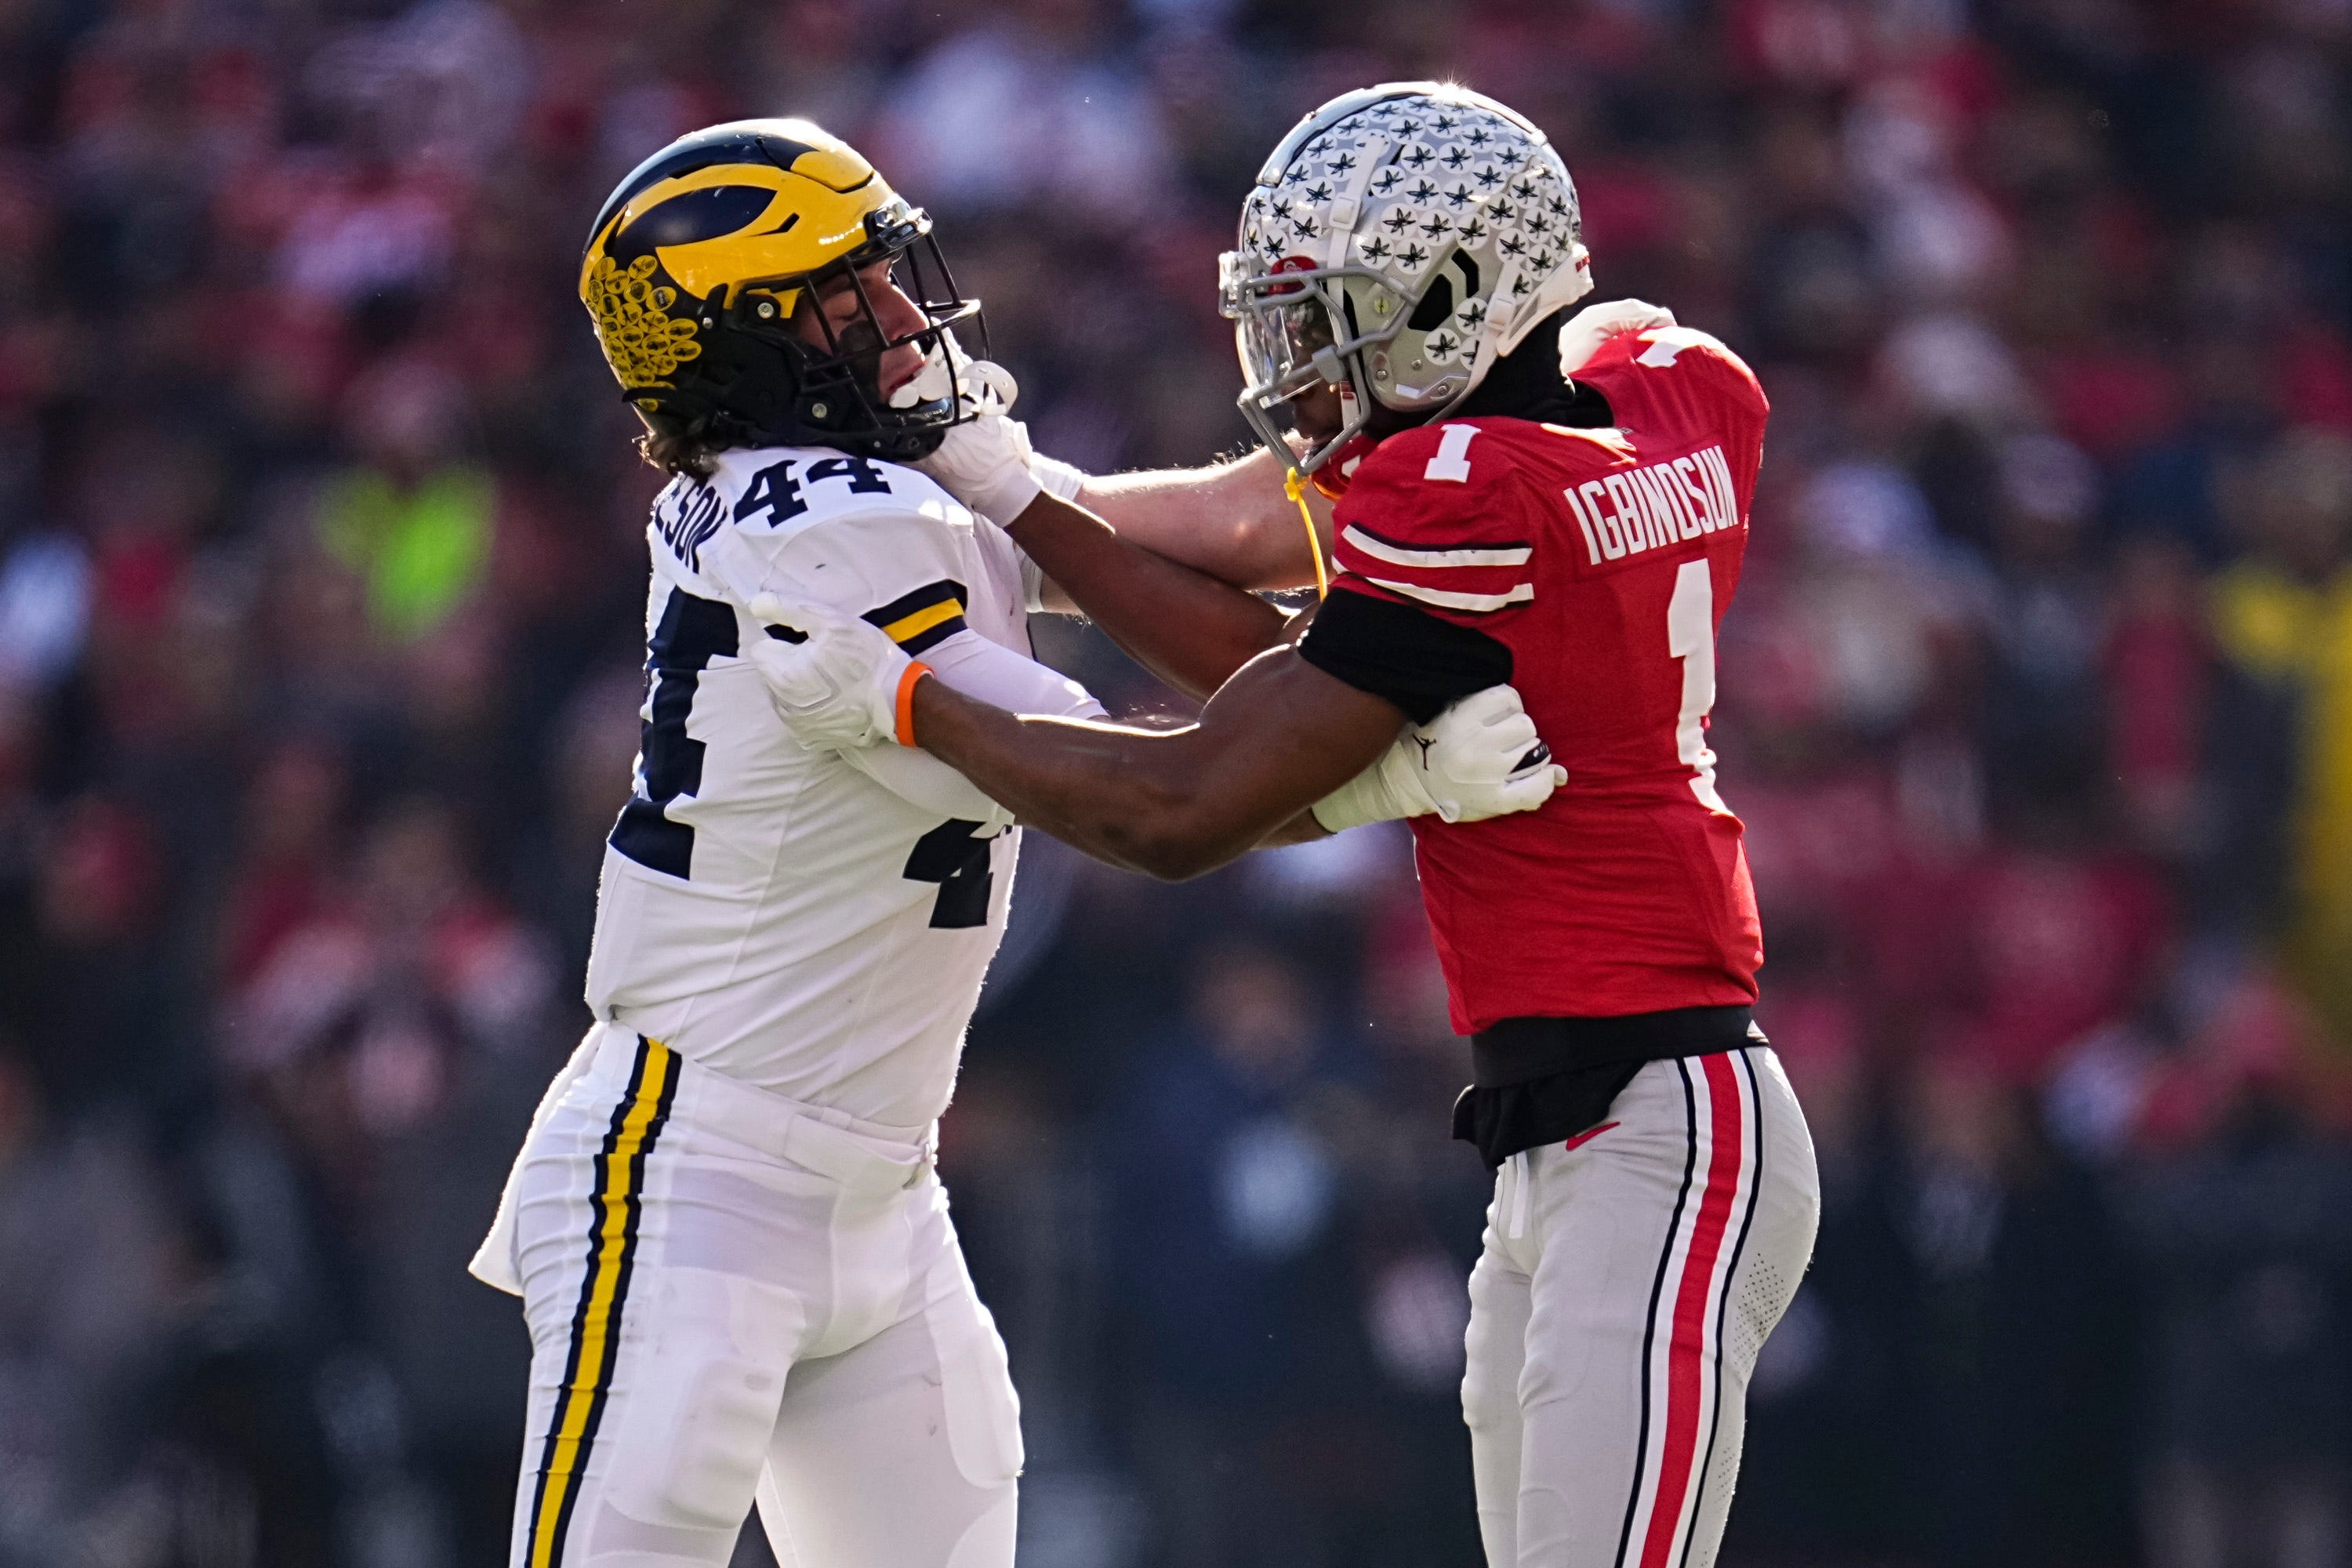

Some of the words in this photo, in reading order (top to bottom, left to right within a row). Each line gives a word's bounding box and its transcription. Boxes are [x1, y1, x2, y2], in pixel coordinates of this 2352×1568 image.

[732, 457, 892, 529] 44
[1423, 423, 1482, 483] 1
[1563, 445, 1739, 565] IGBINOSUN
[1668, 557, 1735, 817] 1
